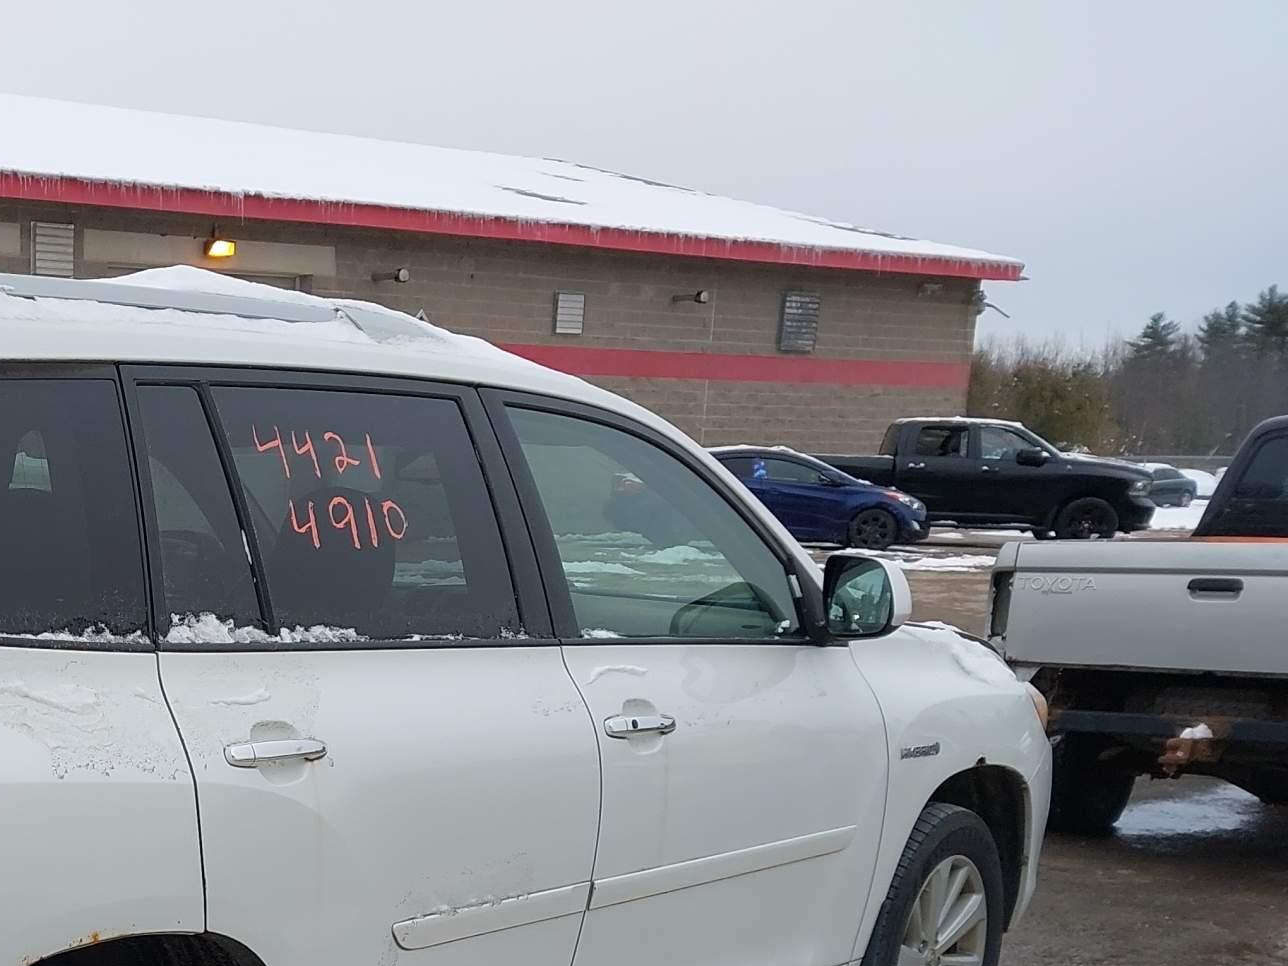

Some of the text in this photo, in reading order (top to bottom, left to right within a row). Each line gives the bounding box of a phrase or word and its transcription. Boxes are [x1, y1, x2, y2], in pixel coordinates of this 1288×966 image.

[252, 423, 382, 480] 4421
[288, 496, 409, 550] 4910
[1017, 575, 1097, 592] TOYOTA
